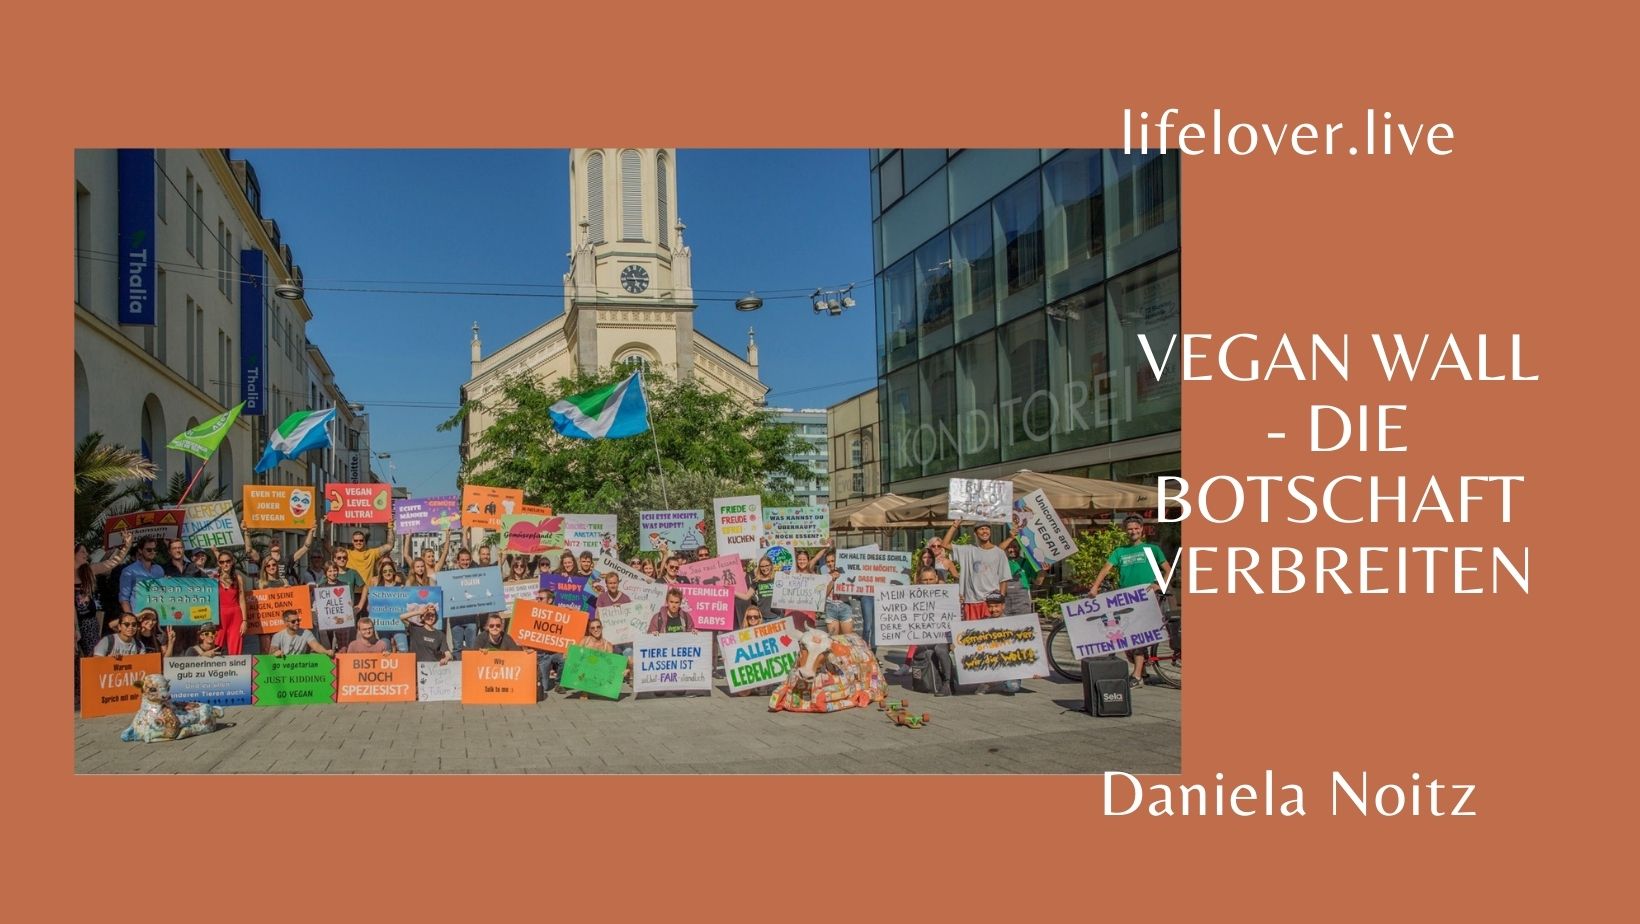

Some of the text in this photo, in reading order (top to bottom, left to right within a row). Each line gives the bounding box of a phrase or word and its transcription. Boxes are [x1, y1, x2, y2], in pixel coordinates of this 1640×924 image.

[130, 249, 147, 314] Thalia
[248, 368, 259, 408] Thalia
[897, 365, 1133, 468] KONDITOREI
[251, 490, 286, 498] EVEN THE
[345, 488, 372, 496] VEGAN
[256, 502, 280, 510] JOKER
[347, 499, 371, 507] LEVEL
[345, 510, 373, 518] ULTRA!
[720, 505, 746, 514] FRIEDE
[216, 517, 233, 529] DIE
[722, 515, 747, 524] FREUDE
[1035, 494, 1071, 551] Unicorns are
[728, 535, 755, 544] KUCHEN
[1034, 518, 1061, 557] VEGAN
[887, 554, 908, 562] SCHILD,
[604, 558, 638, 580] Unicorns
[188, 585, 213, 593] sein
[558, 583, 582, 592] HAPPY
[681, 587, 729, 597] TTERMILCH
[836, 584, 855, 592] NETT
[319, 589, 330, 598] ICH
[880, 588, 949, 600] MEIN KÖRPER
[146, 595, 164, 603] ist
[326, 598, 344, 607] ALLE
[1066, 588, 1149, 618] LASS MEINE
[712, 600, 728, 610] FÜR
[882, 602, 935, 612] WIRD KEIN
[324, 607, 344, 615] TIERE
[531, 608, 571, 624] BIST DU
[698, 616, 725, 625] BABYS
[880, 614, 907, 622] GRAB
[533, 620, 563, 634] NOCH
[909, 622, 951, 630] KREATURE
[518, 629, 576, 648] SPEZIESIST?
[721, 636, 737, 647] FÜR
[754, 620, 786, 637] FREIHEIT
[1076, 630, 1162, 657] TITTEN IN RUHE
[640, 647, 700, 658] TIERE LEBEN
[735, 638, 779, 663] ALLER
[169, 660, 226, 670] VeganerInnen
[272, 661, 318, 670] go vegetarian
[353, 659, 398, 669] BIST DU
[494, 658, 504, 666] Why
[642, 660, 694, 671] LASSEN IST
[477, 666, 521, 680] VEGAN?
[730, 652, 796, 688] LEBEWESEN
[264, 675, 326, 684] JUST KIDDING
[358, 672, 393, 682] NOCH
[660, 673, 677, 682] FAIR
[289, 690, 313, 698] VEGAN
[341, 685, 410, 696] SPEZIESIST?
[1104, 692, 1123, 701] Sela
